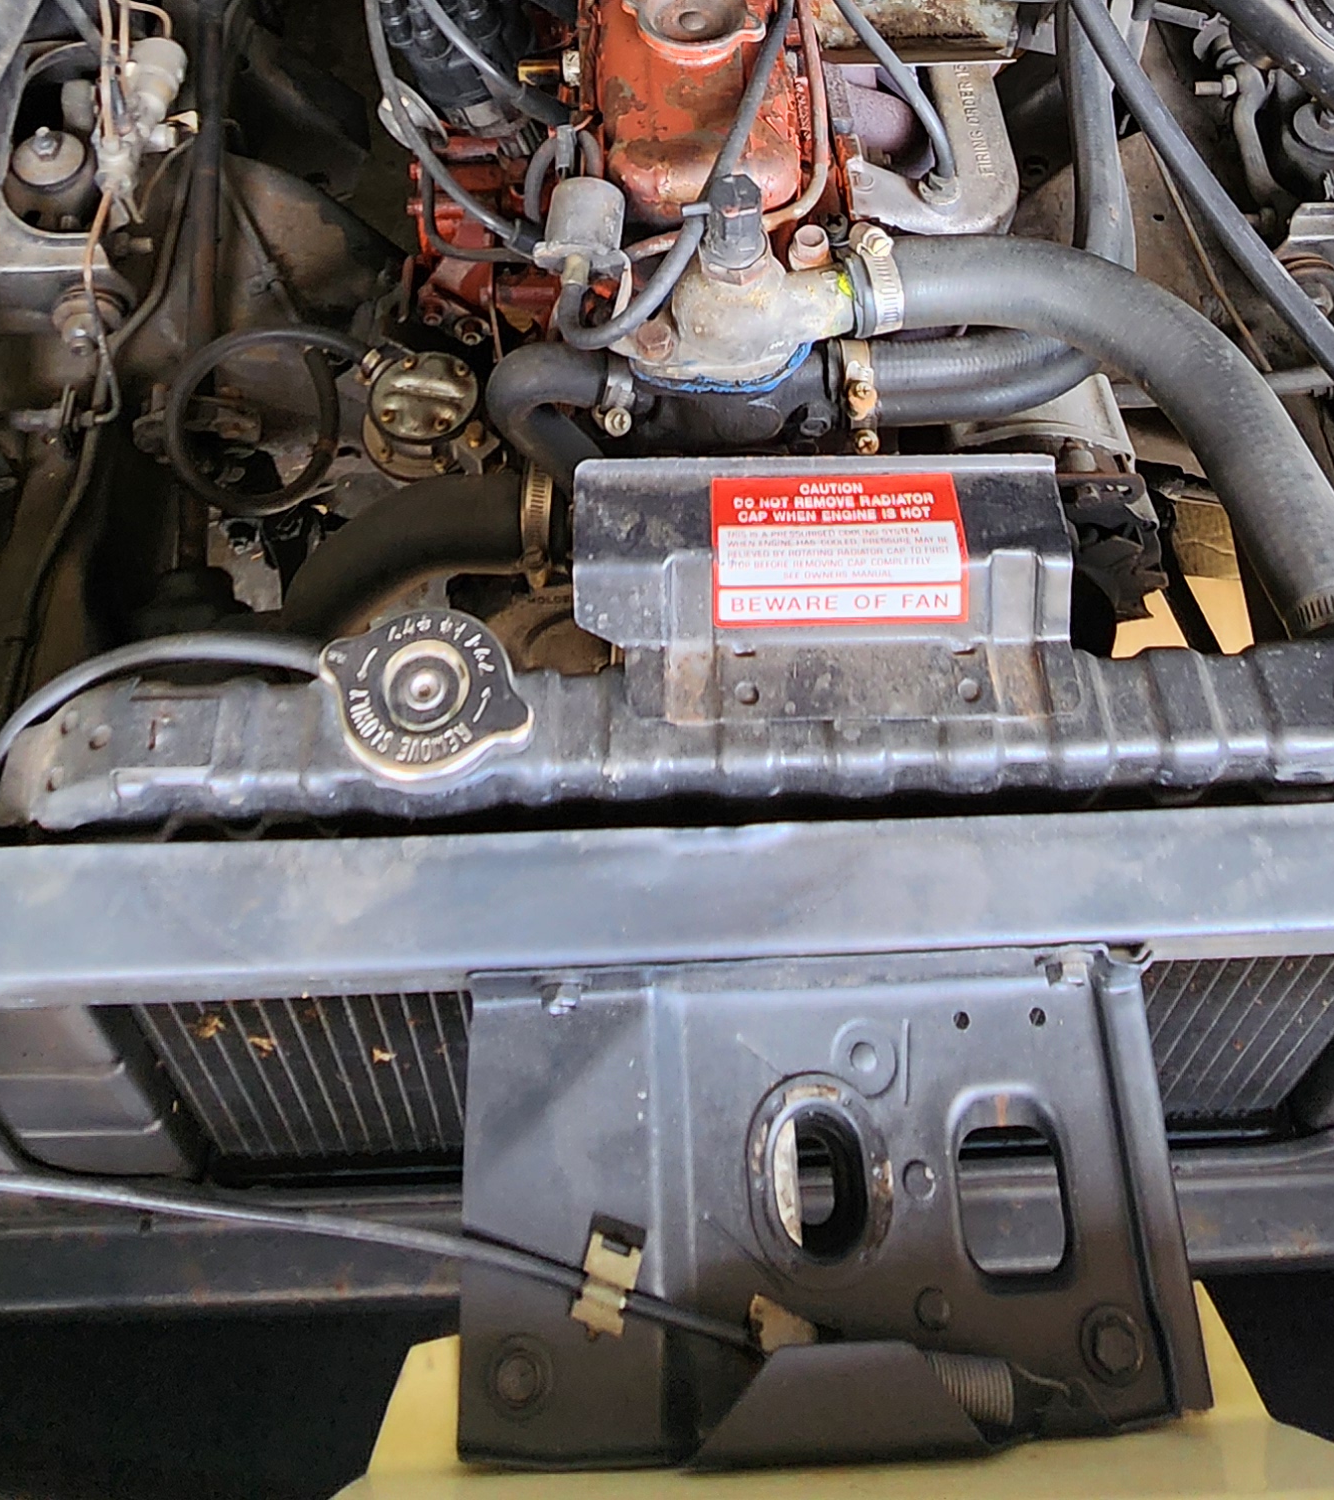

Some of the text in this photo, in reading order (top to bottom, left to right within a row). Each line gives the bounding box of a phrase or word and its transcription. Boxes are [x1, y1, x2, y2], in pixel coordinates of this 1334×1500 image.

[958, 81, 980, 126] ORDER
[970, 130, 995, 177] FIRING
[799, 482, 864, 495] CAUTION
[733, 492, 935, 509] DO NOT REMOVE RADIATOR
[738, 505, 931, 523] CAP WHEN ENGINE IS HOT
[727, 530, 747, 539] THIS
[727, 540, 756, 548] WHEN
[758, 539, 792, 547] ENGINE
[862, 536, 910, 545] PRESSURE
[914, 536, 934, 544] MAY
[772, 549, 785, 557] BY
[788, 548, 834, 557] ROTATING
[837, 548, 884, 556] RADIATOR
[886, 547, 906, 555] CAP
[910, 546, 922, 554] TO
[924, 545, 949, 554] FIRST
[847, 558, 866, 567] CAP
[731, 593, 949, 613] BEWARE OF FAN
[349, 689, 473, 762] REMOVE SLOWLY
